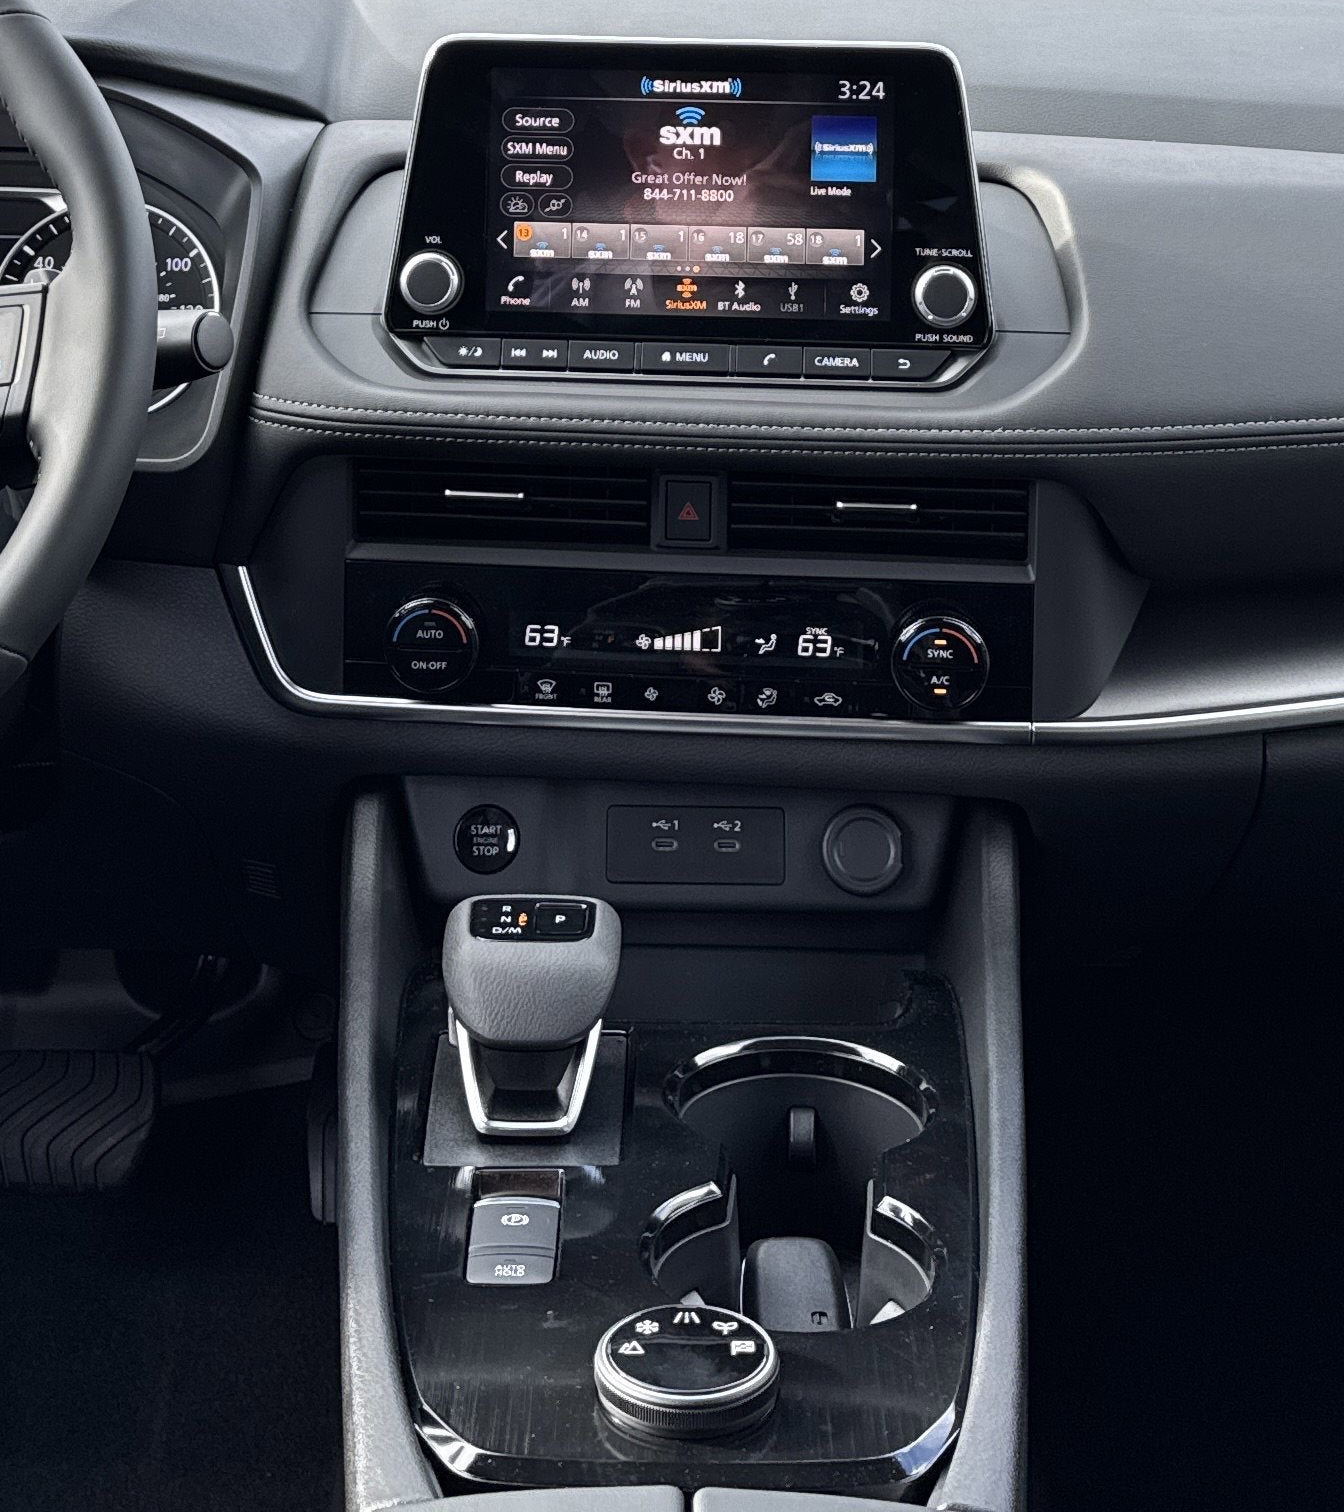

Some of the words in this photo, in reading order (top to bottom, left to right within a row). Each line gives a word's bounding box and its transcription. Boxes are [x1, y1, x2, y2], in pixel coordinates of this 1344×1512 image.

[838, 80, 886, 100] 3:24
[515, 114, 560, 126] Source
[659, 125, 721, 146] sxm
[507, 142, 532, 154] SXM
[536, 143, 567, 156] Menu
[673, 148, 694, 160] Ch.
[699, 148, 705, 159] 1
[515, 170, 553, 186] Replay
[632, 172, 669, 184] Great
[673, 173, 710, 185] Offer
[713, 174, 747, 186] Now!
[643, 189, 734, 202] 844-711-8800
[810, 187, 825, 195] Live
[828, 187, 851, 196] Mode
[425, 236, 442, 244] VOL
[518, 228, 530, 237] 13
[562, 228, 567, 239] 1
[576, 230, 588, 239] 14
[620, 230, 625, 241] 1
[635, 231, 647, 240] 15
[678, 231, 684, 242] 1
[693, 232, 705, 242] 16
[729, 231, 744, 244] 18
[752, 234, 764, 243] 17
[787, 234, 803, 245] 58
[810, 235, 823, 244] 18
[855, 235, 861, 246] 1
[34, 256, 54, 269] 40
[166, 258, 191, 271] 100
[501, 296, 531, 306] Phone
[572, 297, 589, 307] AM
[625, 299, 640, 308] FM
[665, 300, 706, 310] SiriusXM
[718, 301, 729, 310] BT
[732, 302, 761, 312] Audio
[780, 303, 804, 312] USB1
[840, 304, 878, 315] Settings
[413, 319, 437, 328] PUSH
[915, 334, 939, 342] PUSH
[943, 334, 973, 343] SOUND
[583, 349, 618, 360] AUDIO
[676, 352, 708, 362] MENU
[815, 356, 859, 368] CAMERA
[416, 630, 444, 639] AUTO
[806, 627, 828, 635] SYNC
[927, 649, 953, 659] SYNC
[931, 676, 950, 685] A/C
[471, 825, 502, 835] START
[673, 820, 678, 830] 1
[734, 820, 741, 831] 2
[473, 846, 500, 856] STOP
[555, 915, 566, 923] P
